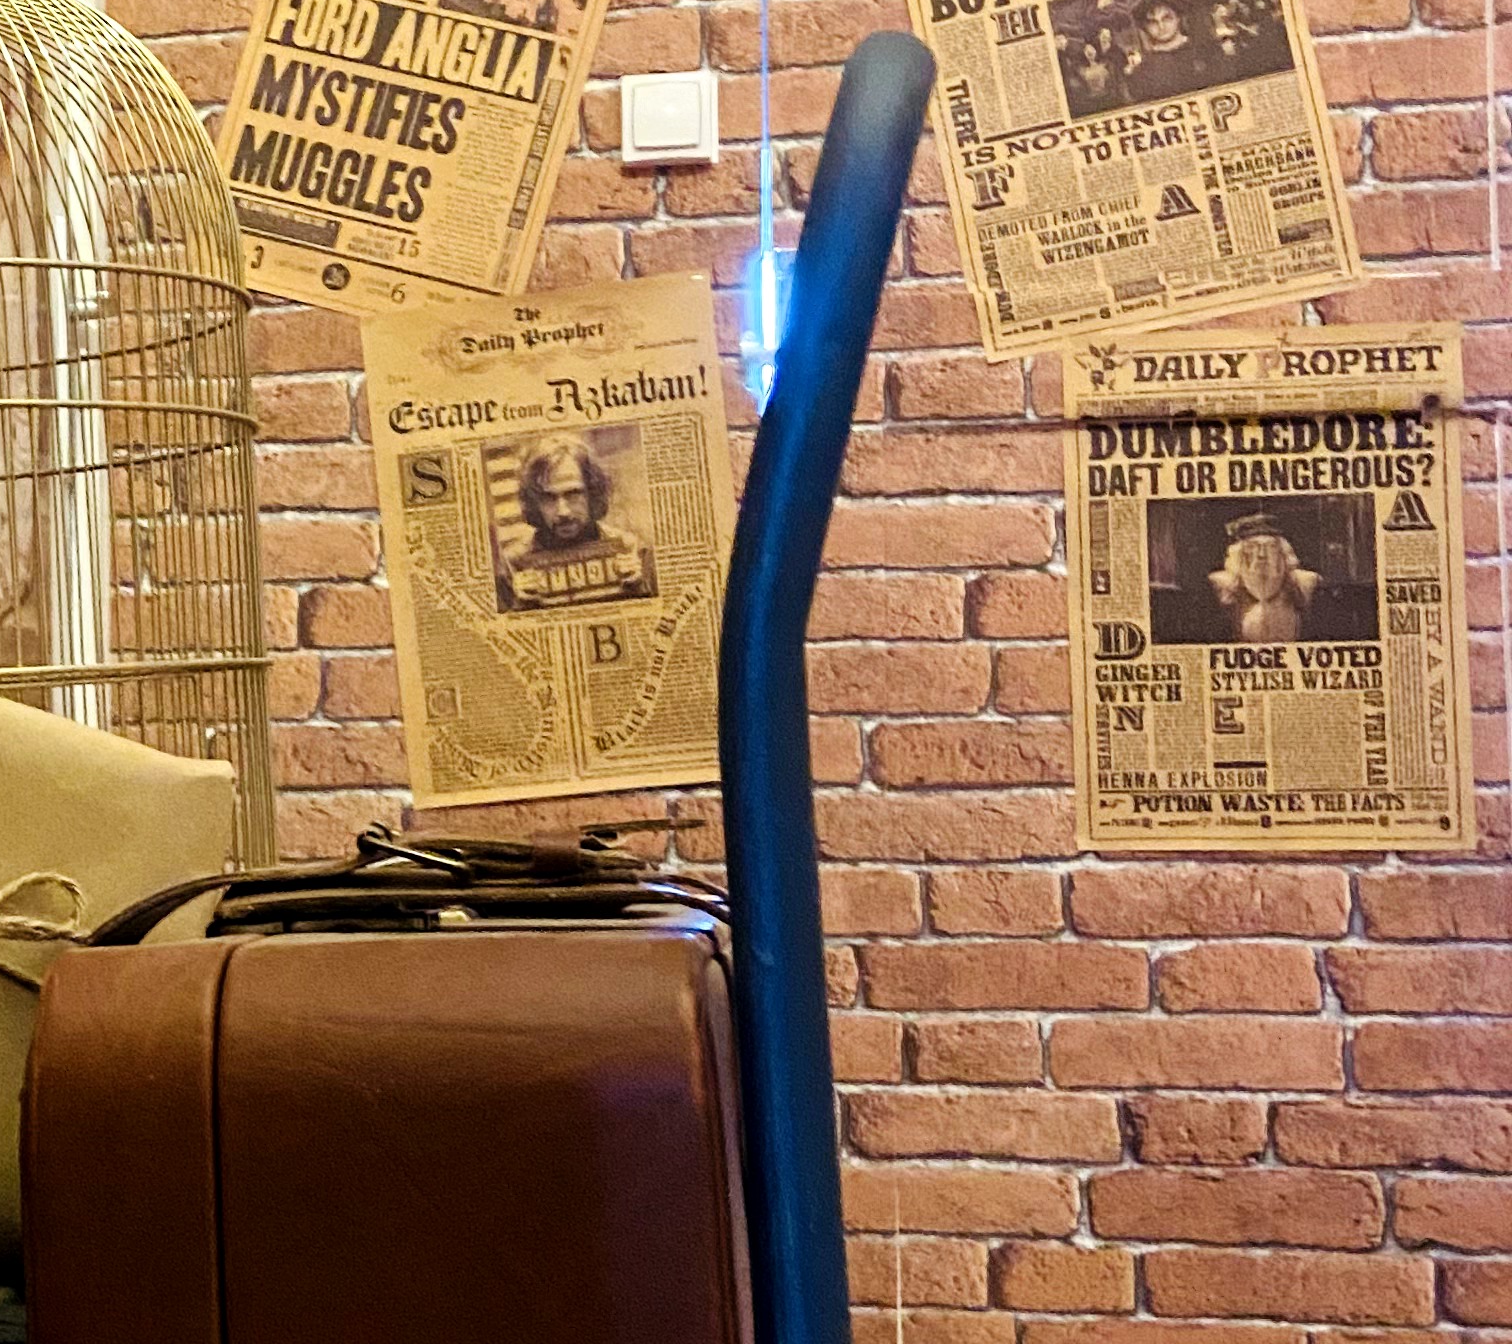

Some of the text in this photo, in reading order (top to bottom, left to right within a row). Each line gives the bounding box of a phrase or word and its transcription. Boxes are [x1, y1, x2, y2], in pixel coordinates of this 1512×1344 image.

[380, 11, 545, 102] ANGLIA
[250, 53, 467, 155] MYSTIFIES
[946, 79, 980, 148] THERE
[1208, 91, 1242, 133] P
[961, 104, 1185, 168] IS NOTHING
[1078, 123, 1189, 165] TO FEAR!
[230, 124, 432, 223] MUGGLES
[964, 163, 1015, 212] F
[977, 194, 1142, 243] DEMOTED FROM CHIEF
[1155, 183, 1202, 222] A
[1037, 213, 1148, 247] WARLOCK in the
[1041, 227, 1151, 266] WIZENGAMOT
[390, 282, 406, 304] 6
[514, 307, 541, 323] The
[460, 336, 516, 355] Daily
[520, 321, 605, 351] Prophet
[1133, 352, 1248, 383] DAILY
[388, 364, 709, 435] Escape from Azkaban!
[1088, 409, 1436, 460] DUMBLEDORE:
[409, 458, 448, 504] S
[1088, 453, 1436, 497] DAFT OR DANGEROUS?
[1382, 489, 1436, 531] A
[1385, 582, 1442, 605] SAVED
[1389, 607, 1421, 635] M
[589, 623, 623, 664] B
[1209, 644, 1383, 670] FUDGE VOTED
[1426, 649, 1444, 673] A
[1095, 663, 1182, 683] GINGER
[1095, 682, 1183, 704] WITCH
[1210, 668, 1383, 692] STYLISH WIZARD
[1113, 706, 1145, 732] N
[1212, 694, 1245, 735] E
[1363, 690, 1389, 787] OF THE YEAR
[1097, 768, 1268, 791] HENNA EXPLOSION
[1132, 792, 1214, 813] POTION
[1311, 793, 1347, 813] THE
[1351, 793, 1406, 813] FACTS
